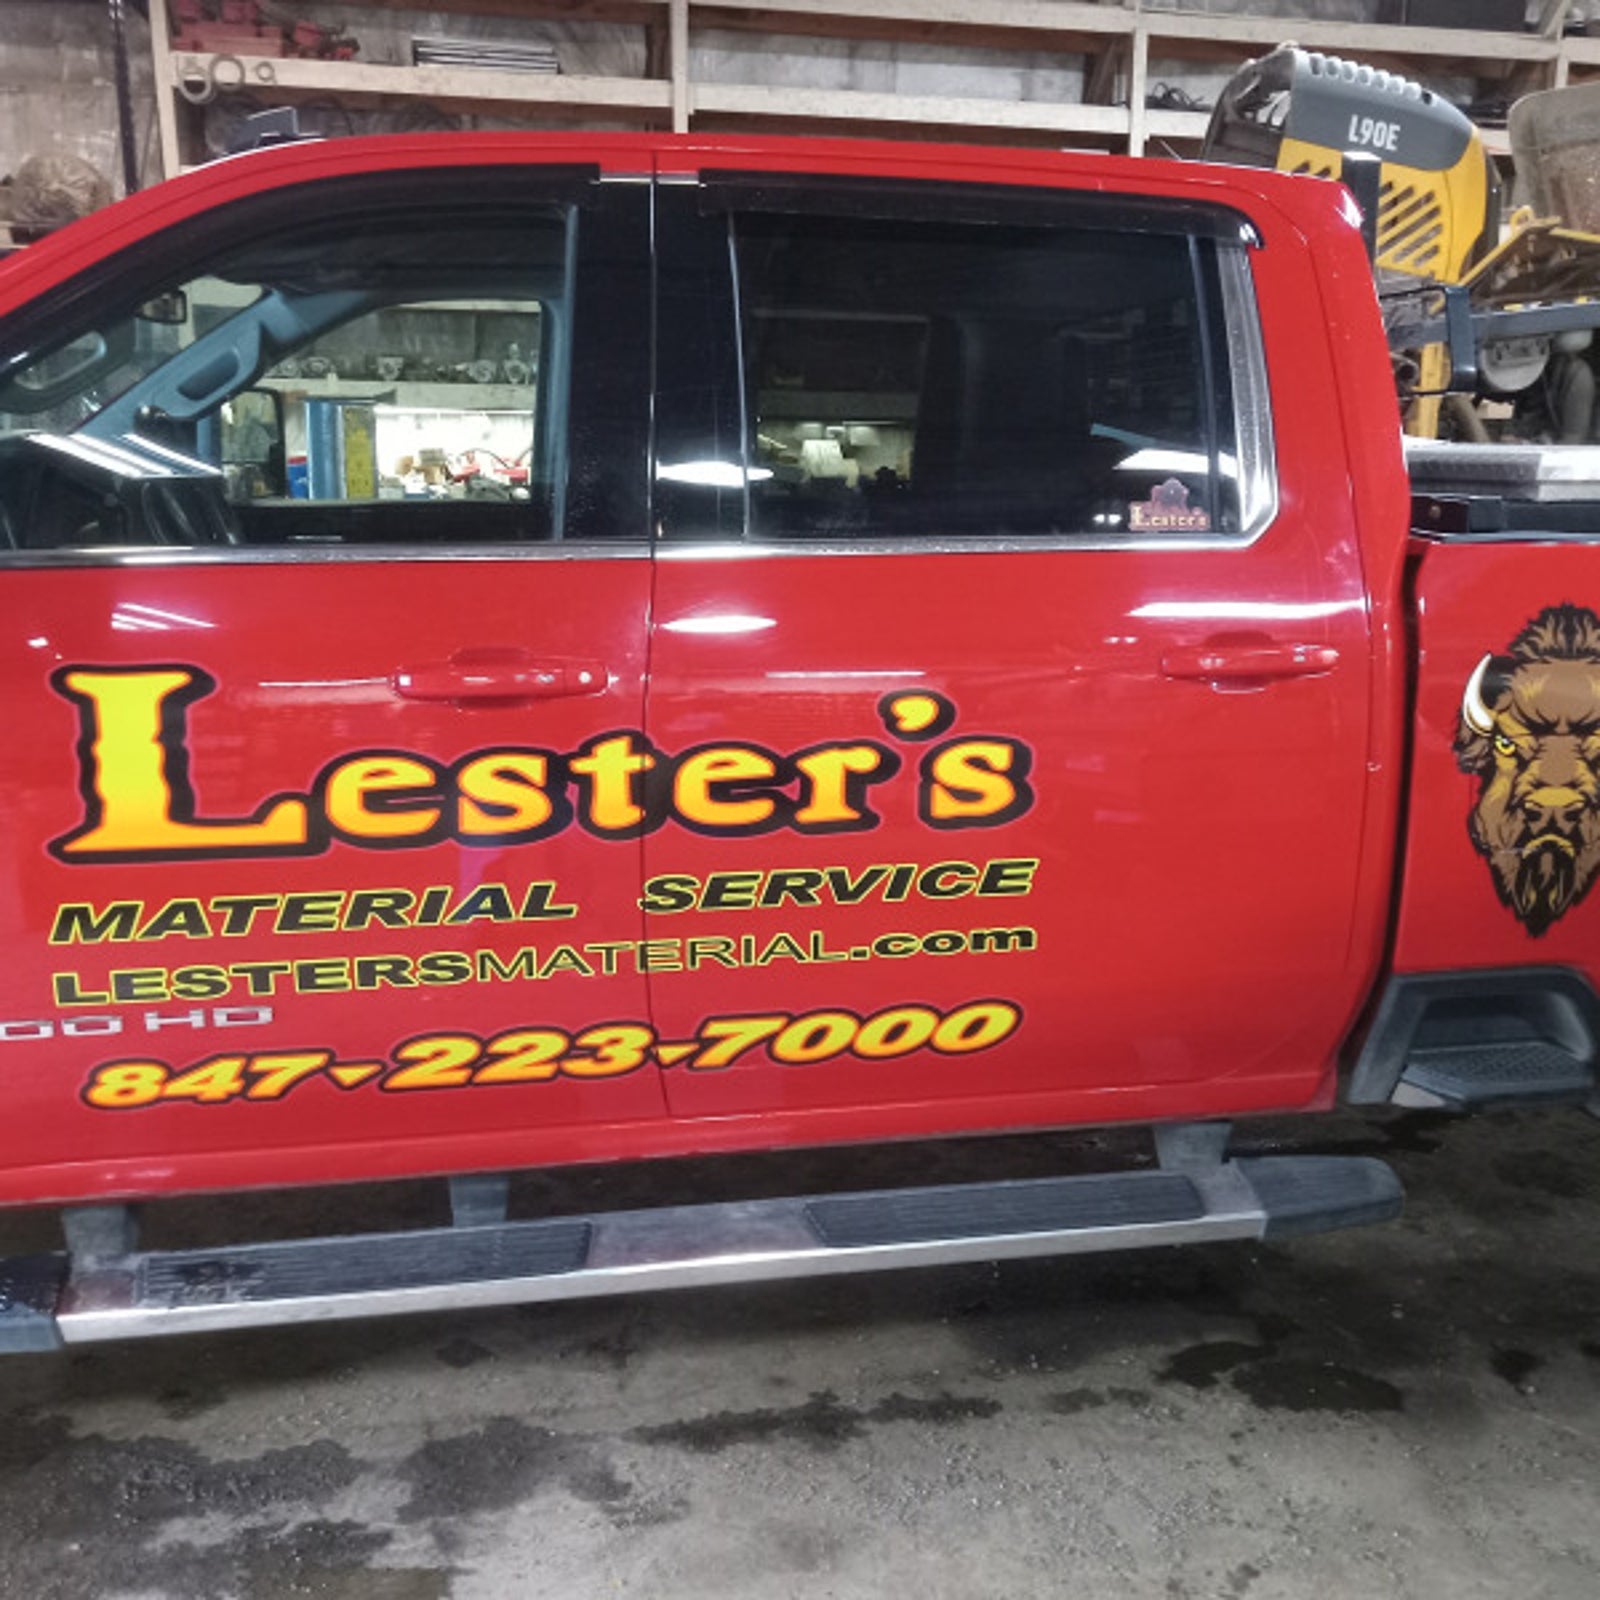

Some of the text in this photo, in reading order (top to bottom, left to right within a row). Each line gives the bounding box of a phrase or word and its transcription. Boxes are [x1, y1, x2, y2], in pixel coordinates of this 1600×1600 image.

[1348, 114, 1401, 151] L90E
[49, 665, 1034, 862] Lester's
[49, 858, 1040, 944] MATERIAL SERVICE
[53, 927, 1036, 1006] LESTERSMATERIAL.com
[144, 1006, 273, 1032] HD
